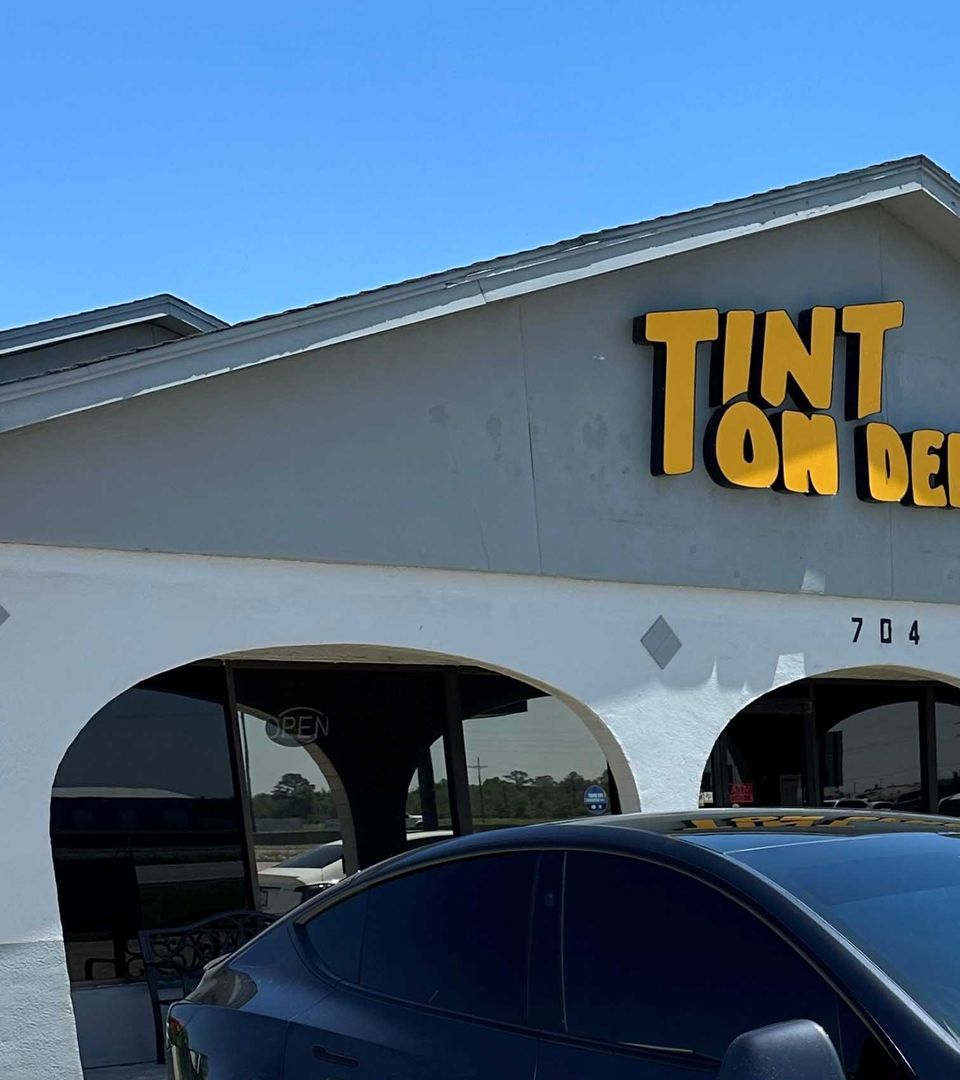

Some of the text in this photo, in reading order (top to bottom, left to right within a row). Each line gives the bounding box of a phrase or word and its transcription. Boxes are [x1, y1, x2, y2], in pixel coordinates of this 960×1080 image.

[638, 301, 904, 477] TINT
[707, 400, 839, 496] ON
[850, 617, 921, 645] 704
[265, 715, 329, 739] OPEN
